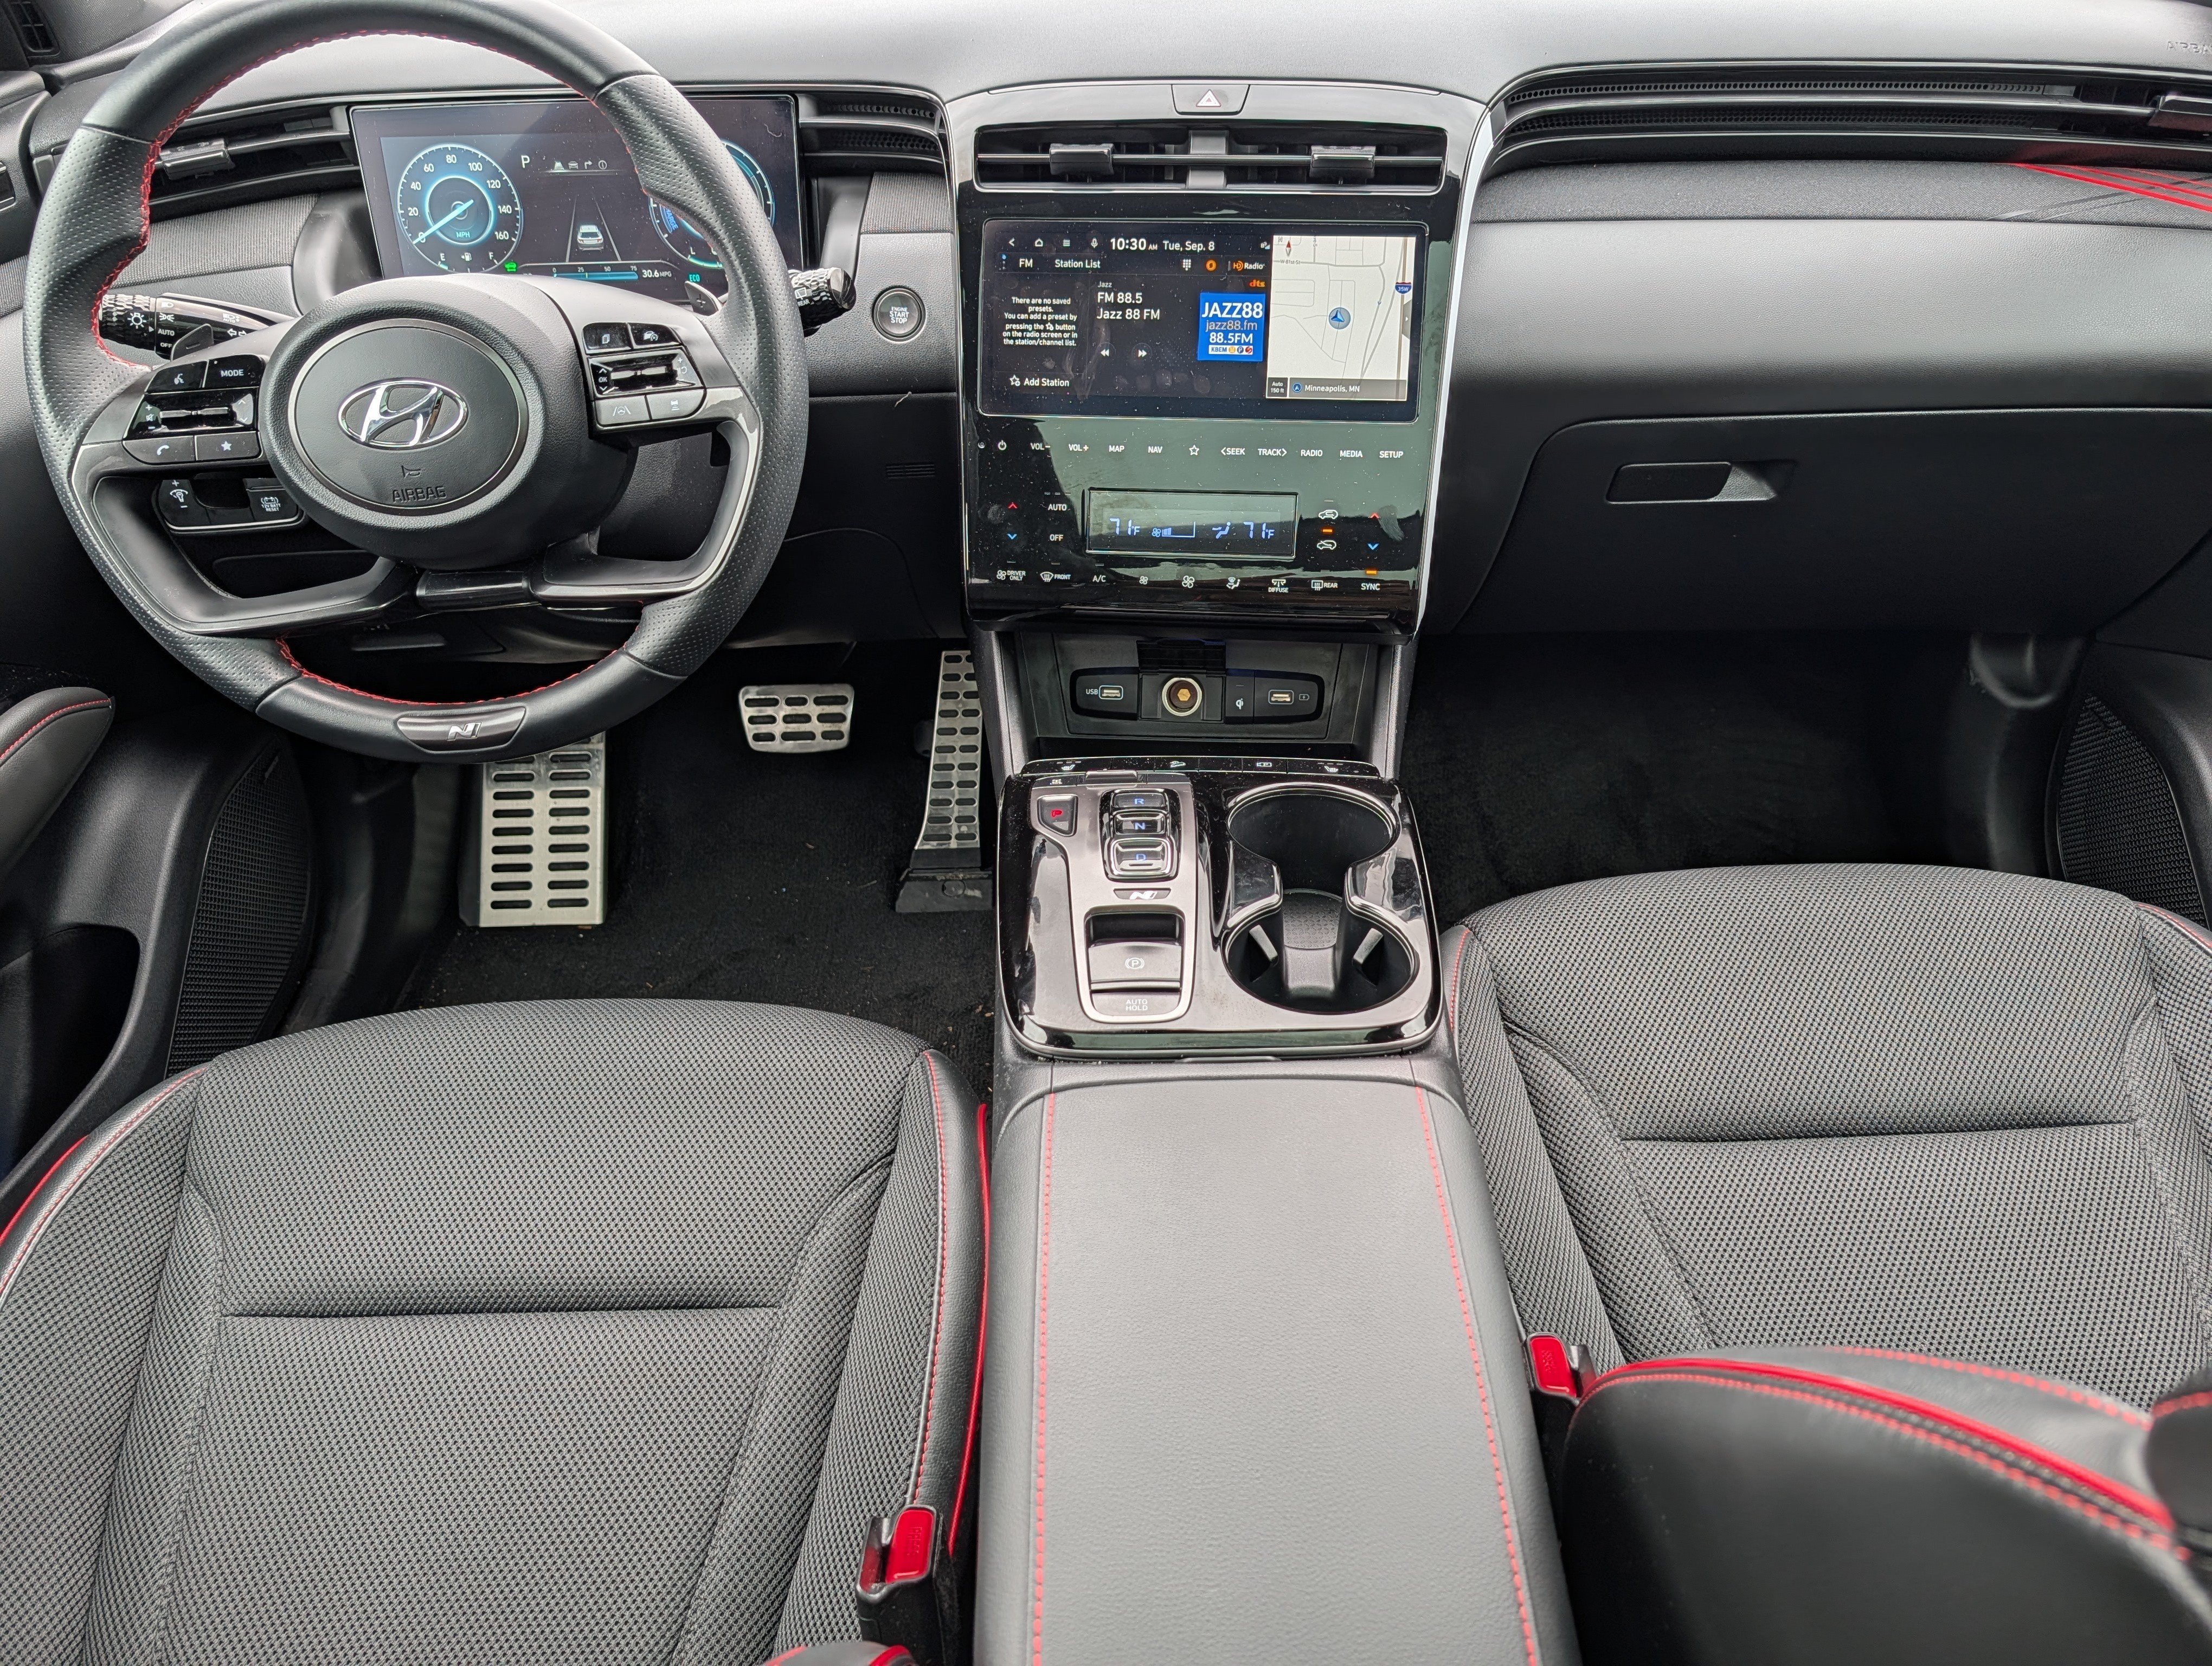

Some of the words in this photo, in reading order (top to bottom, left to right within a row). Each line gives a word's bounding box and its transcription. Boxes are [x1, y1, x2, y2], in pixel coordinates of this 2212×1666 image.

[2167, 41, 2212, 55] AIRBA
[446, 155, 456, 164] 80
[520, 155, 530, 169] P
[423, 163, 434, 172] 60
[468, 162, 483, 171] 100
[410, 182, 421, 190] 40
[486, 180, 501, 189] 120
[408, 207, 419, 216] 20
[498, 204, 512, 214] 140
[494, 232, 509, 241] 160
[1110, 238, 1147, 251] 10:30
[1163, 240, 1183, 251] Tue,
[1185, 241, 1206, 252] Sep.
[1208, 241, 1215, 251] 8
[440, 253, 446, 261] E
[1019, 259, 1033, 267] FM
[1054, 259, 1083, 268] Station
[1085, 260, 1101, 268] List
[642, 270, 659, 278] 30.6
[1097, 292, 1114, 303] FM
[1117, 292, 1142, 303] 88.5
[1097, 309, 1122, 319] Jazz
[1125, 309, 1140, 319] 88
[1143, 309, 1160, 319] FM
[1201, 302, 1263, 319] JAZZ88
[1070, 313, 1077, 322] by
[1205, 319, 1257, 332] jazz88.fm
[1210, 332, 1253, 344] 88.5FM
[220, 369, 244, 377] MODE
[1024, 378, 1039, 387] Add
[1041, 378, 1070, 387] Station
[1304, 385, 1347, 393] Minneapolis,
[1109, 445, 1125, 453] MAP
[1379, 451, 1404, 459] SETUP
[392, 486, 447, 503] AIRBAG
